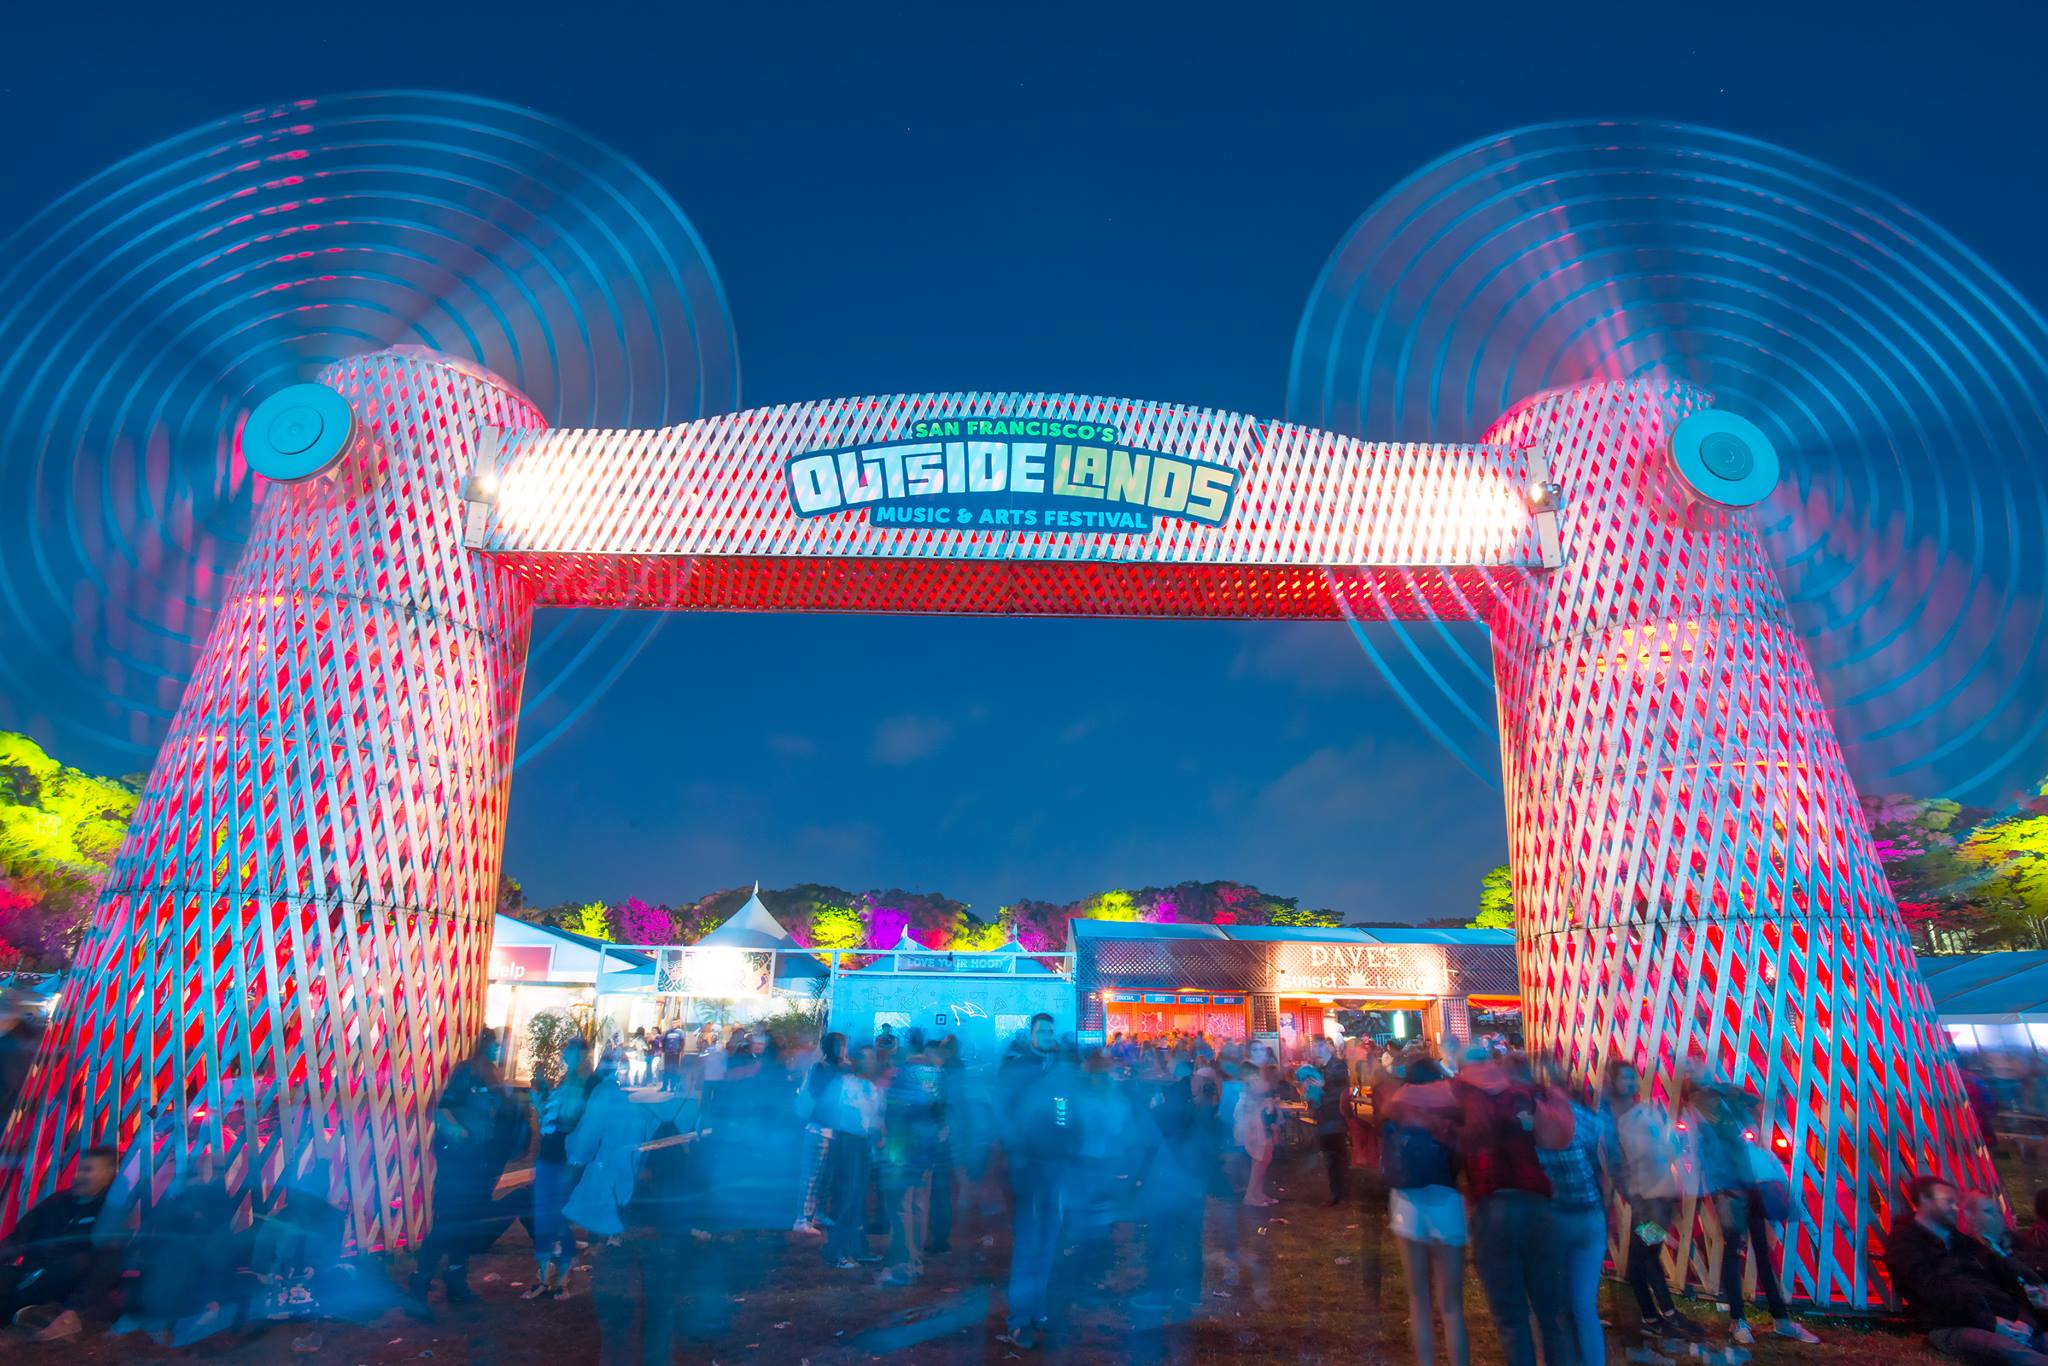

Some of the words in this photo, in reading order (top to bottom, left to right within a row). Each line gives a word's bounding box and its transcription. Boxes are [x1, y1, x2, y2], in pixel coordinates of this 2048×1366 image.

[915, 422, 961, 439] SAN
[967, 421, 1115, 443] FRANCISCO'S
[791, 441, 1046, 513] OUTSIDE
[1053, 444, 1234, 522] LANDS
[876, 507, 949, 523] MUSIC
[957, 508, 974, 524] &
[981, 509, 1037, 526] ARTS
[1044, 511, 1148, 530] FESTIVAL
[907, 958, 934, 968] LOVE
[971, 959, 1003, 969] HOOD
[1311, 945, 1400, 967] DAVE'S
[494, 961, 525, 980] elp
